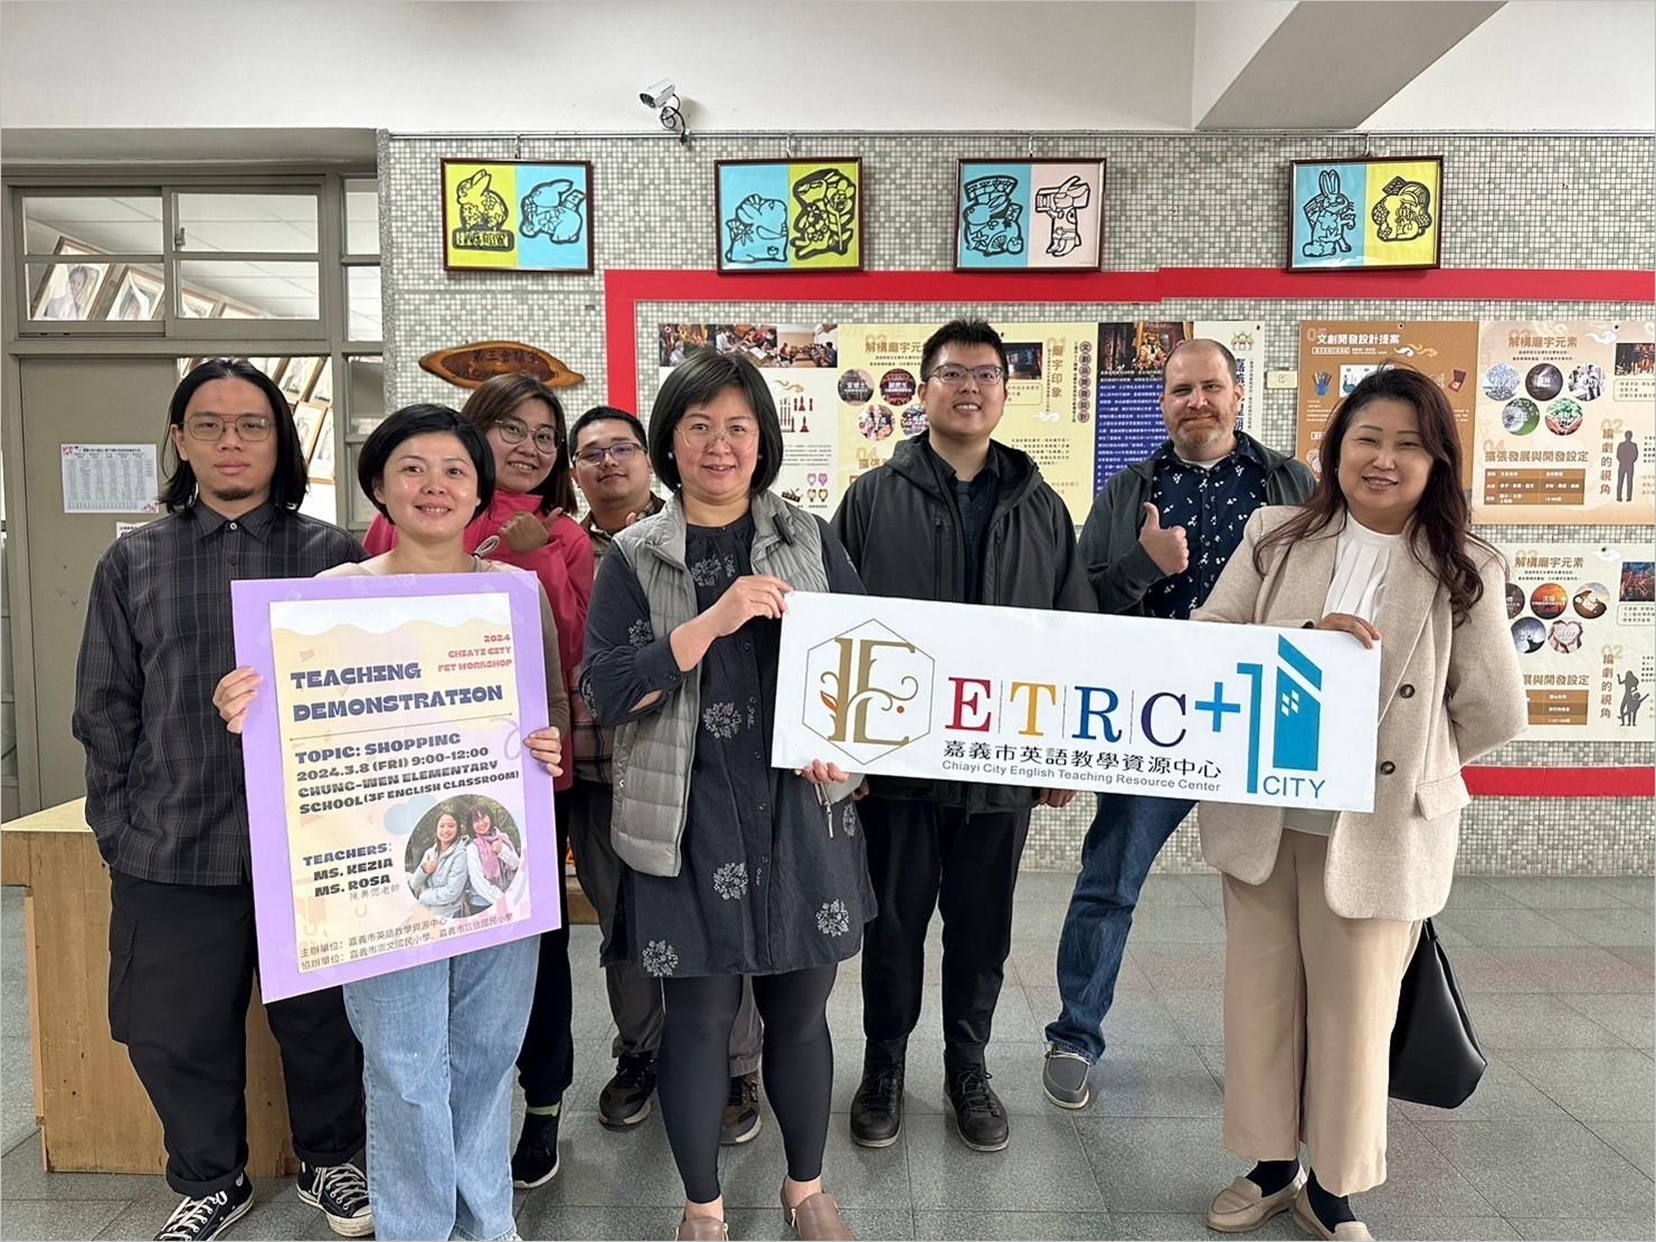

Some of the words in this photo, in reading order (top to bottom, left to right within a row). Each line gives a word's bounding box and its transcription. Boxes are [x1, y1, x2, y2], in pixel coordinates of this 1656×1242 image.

[865, 341, 922, 353] 解構廟宇元
[484, 634, 511, 642] 2024
[448, 648, 486, 658] CHIAYI
[488, 646, 511, 655] CITY
[290, 662, 422, 690] TEACHING
[458, 659, 512, 671] WORKSHOP
[292, 684, 504, 723] DEMONSTRATION
[295, 746, 361, 764] TOPIC:
[364, 733, 461, 756] SHOPPING
[943, 740, 1222, 778] 嘉義市英語教學資源中心
[297, 763, 370, 782] 2024.3.8
[373, 757, 409, 772] (FRI)
[411, 747, 489, 766] 9:00-12:00
[402, 760, 498, 783] ELEMENTARY
[942, 760, 980, 773] Chiayi
[983, 763, 1007, 775] City
[1010, 766, 1055, 778] English
[1058, 769, 1113, 784] Teaching
[1116, 774, 1175, 787] Resource
[1178, 779, 1221, 791] Center
[387, 783, 441, 799] ENGLISH
[443, 770, 519, 790] CLASSROOM)
[1263, 775, 1326, 799] CITY
[303, 843, 392, 866] TEACHERS:
[314, 867, 344, 881] MS.
[347, 858, 394, 875] KEZIA
[315, 884, 345, 898] MS.
[348, 874, 391, 891] ROSA
